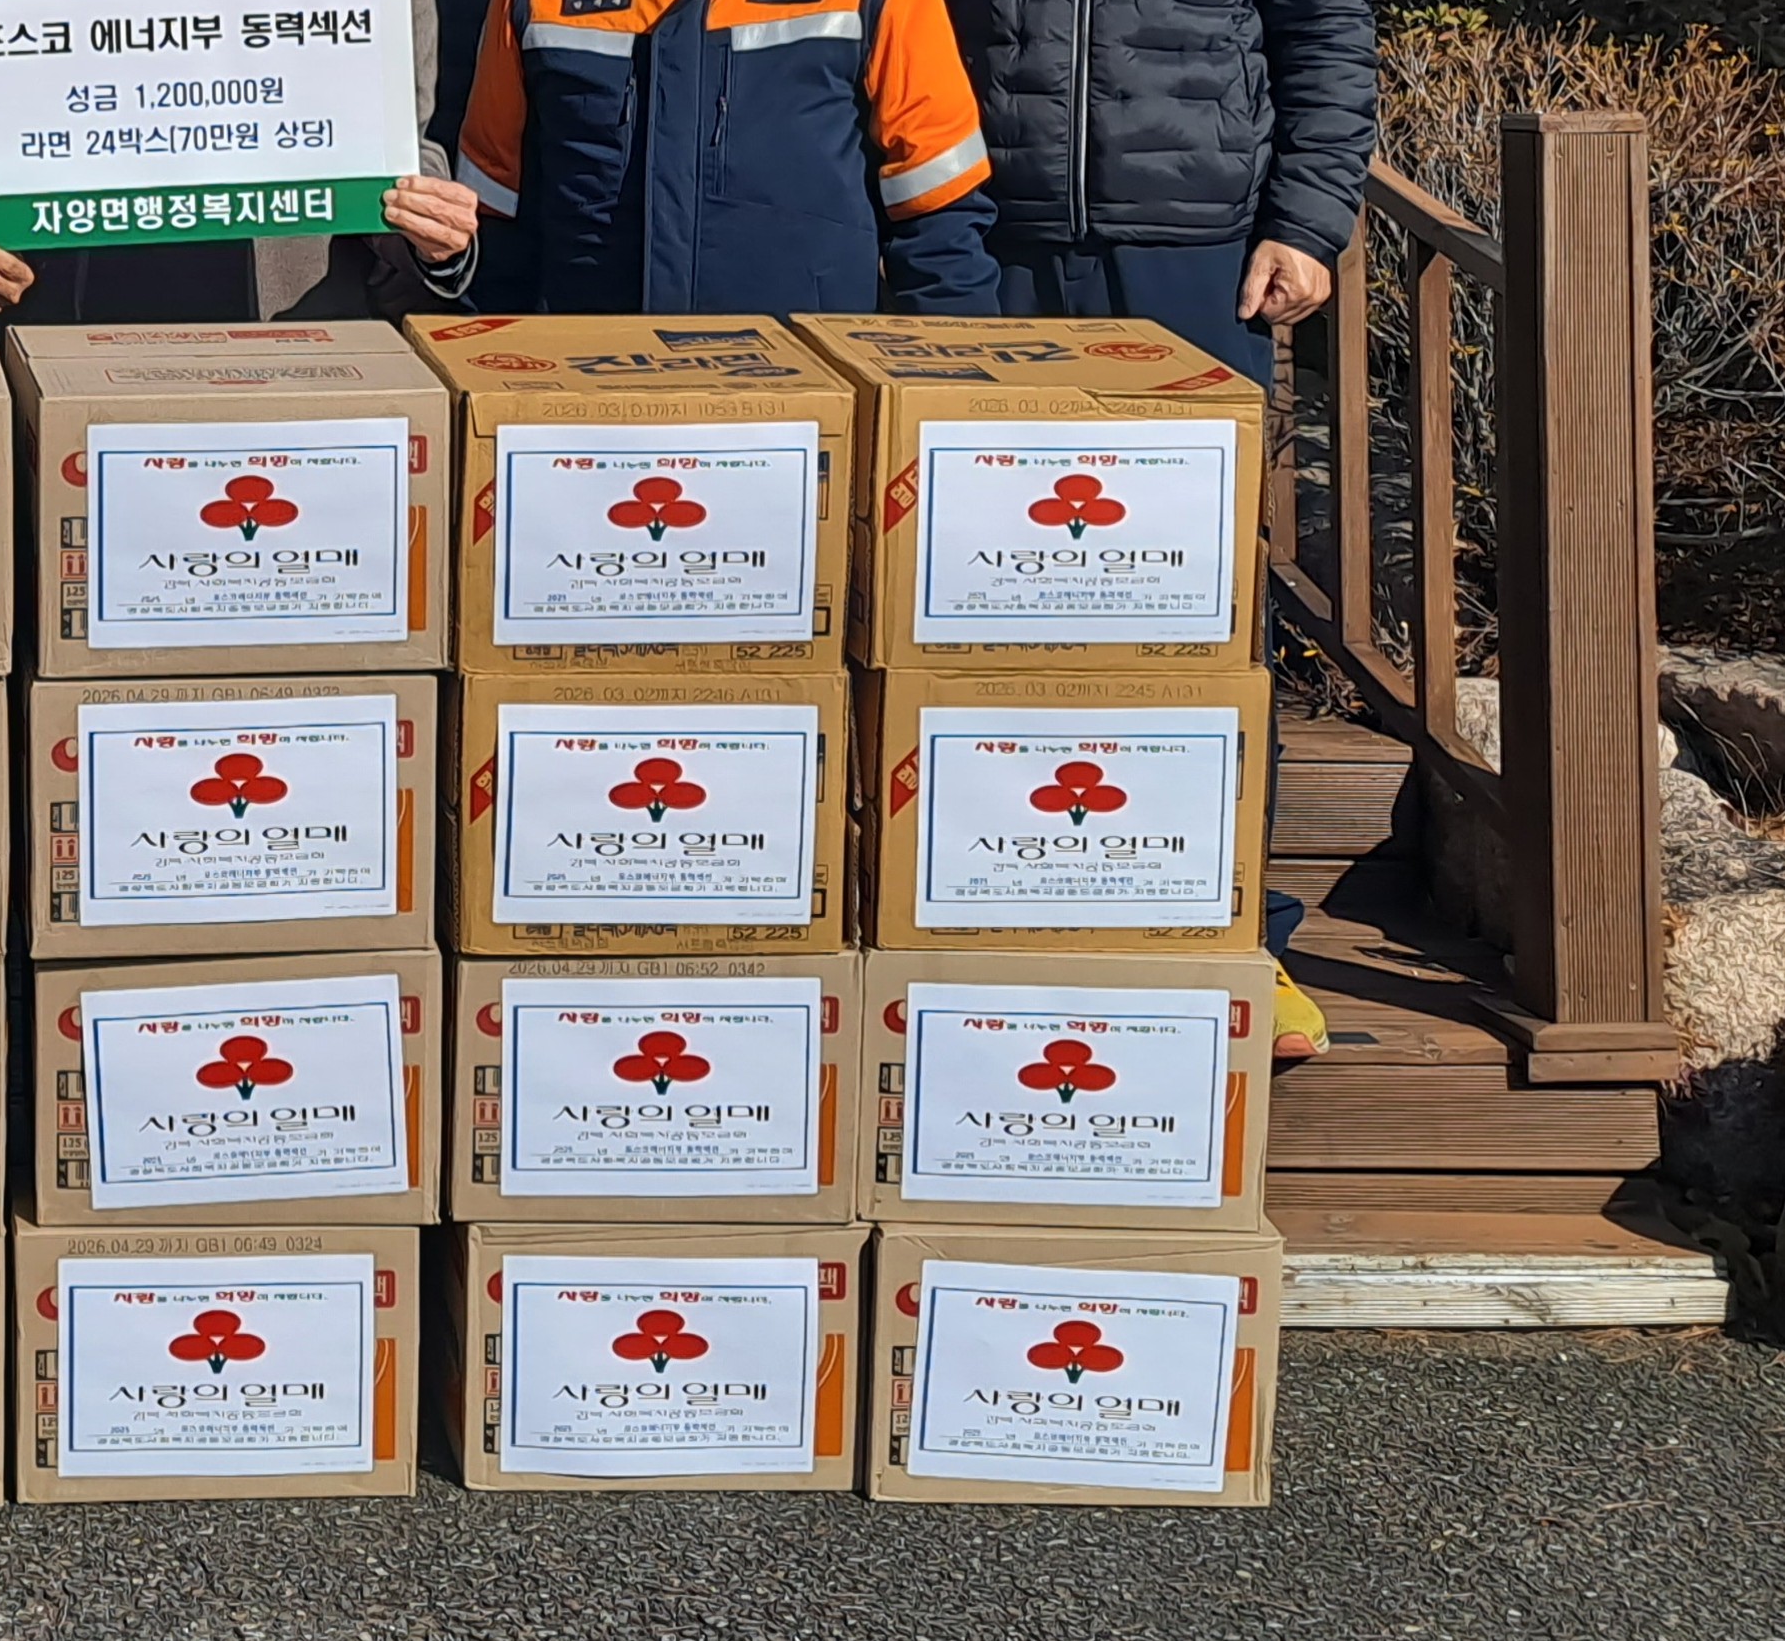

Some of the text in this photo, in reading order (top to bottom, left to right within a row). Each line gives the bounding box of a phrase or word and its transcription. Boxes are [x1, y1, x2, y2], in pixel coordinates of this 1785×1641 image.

[89, 14, 222, 54] 에너지부
[240, 8, 373, 48] 동력섹션
[65, 76, 285, 113] 성금 1,200,000원
[20, 130, 72, 159] 라면
[31, 187, 335, 235] 자양면행정복지센터
[138, 550, 261, 579] 사랑의
[545, 551, 667, 578] 사랑의
[966, 549, 1087, 575] 사랑의
[129, 827, 251, 857] 사랑의
[545, 832, 666, 857] 사랑의
[967, 835, 1088, 861] 사랑의
[137, 1109, 259, 1141] 사랑의
[551, 1104, 673, 1130] 사랑의
[954, 1110, 1076, 1138] 사랑의
[108, 1383, 228, 1410] 사랑의
[550, 1383, 671, 1408] 사랑의
[962, 1388, 1083, 1419] 사랑의
